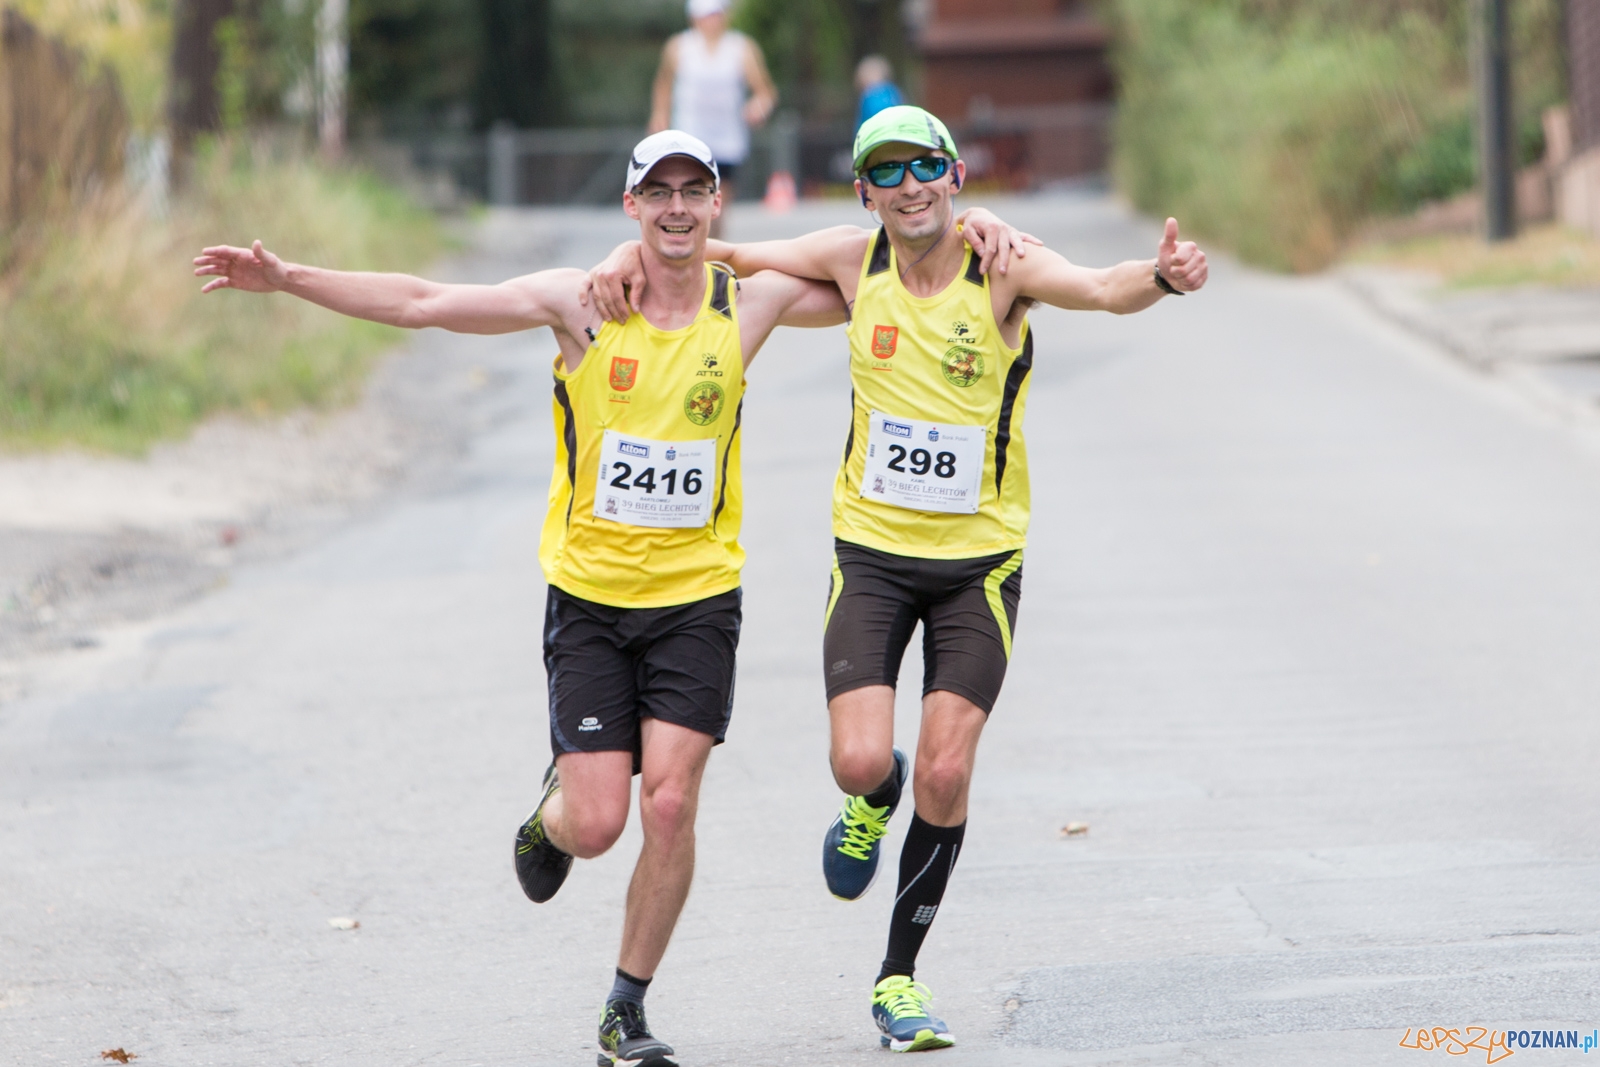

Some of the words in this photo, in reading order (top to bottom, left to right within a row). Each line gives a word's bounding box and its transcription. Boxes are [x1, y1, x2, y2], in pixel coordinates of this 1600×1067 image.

[887, 444, 956, 478] 298
[610, 461, 703, 495] 2416
[888, 479, 898, 488] 39
[900, 482, 920, 492] BIEG
[922, 485, 969, 497] LECHITÓW
[622, 500, 633, 509] 39
[635, 502, 657, 511] BIEG
[660, 502, 703, 512] LECHITÓW
